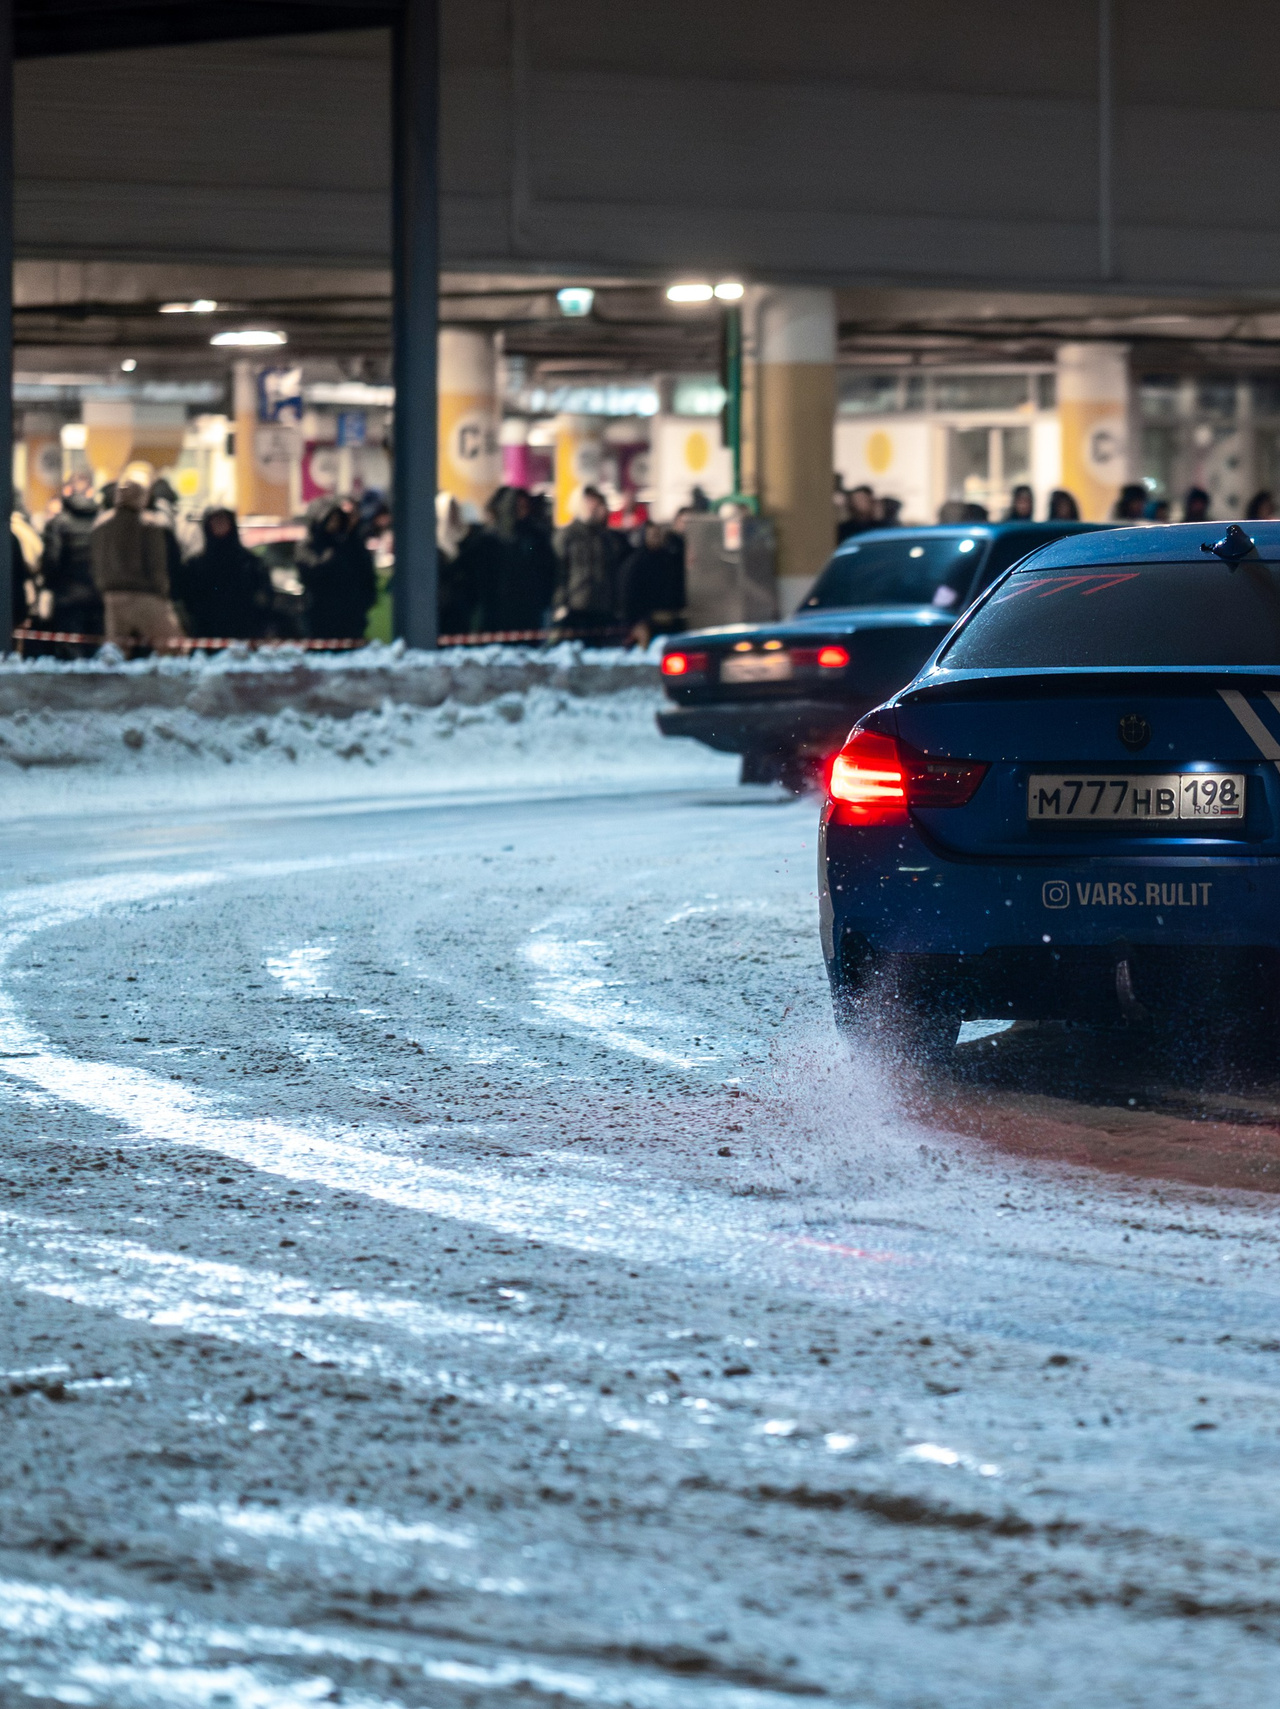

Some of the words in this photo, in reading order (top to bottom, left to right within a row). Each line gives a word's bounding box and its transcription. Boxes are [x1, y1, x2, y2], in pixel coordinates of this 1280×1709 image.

[992, 572, 1142, 605] 777
[1184, 779, 1236, 806] 198
[1194, 804, 1220, 815] RUS
[1076, 882, 1213, 907] VARS.RULIT
